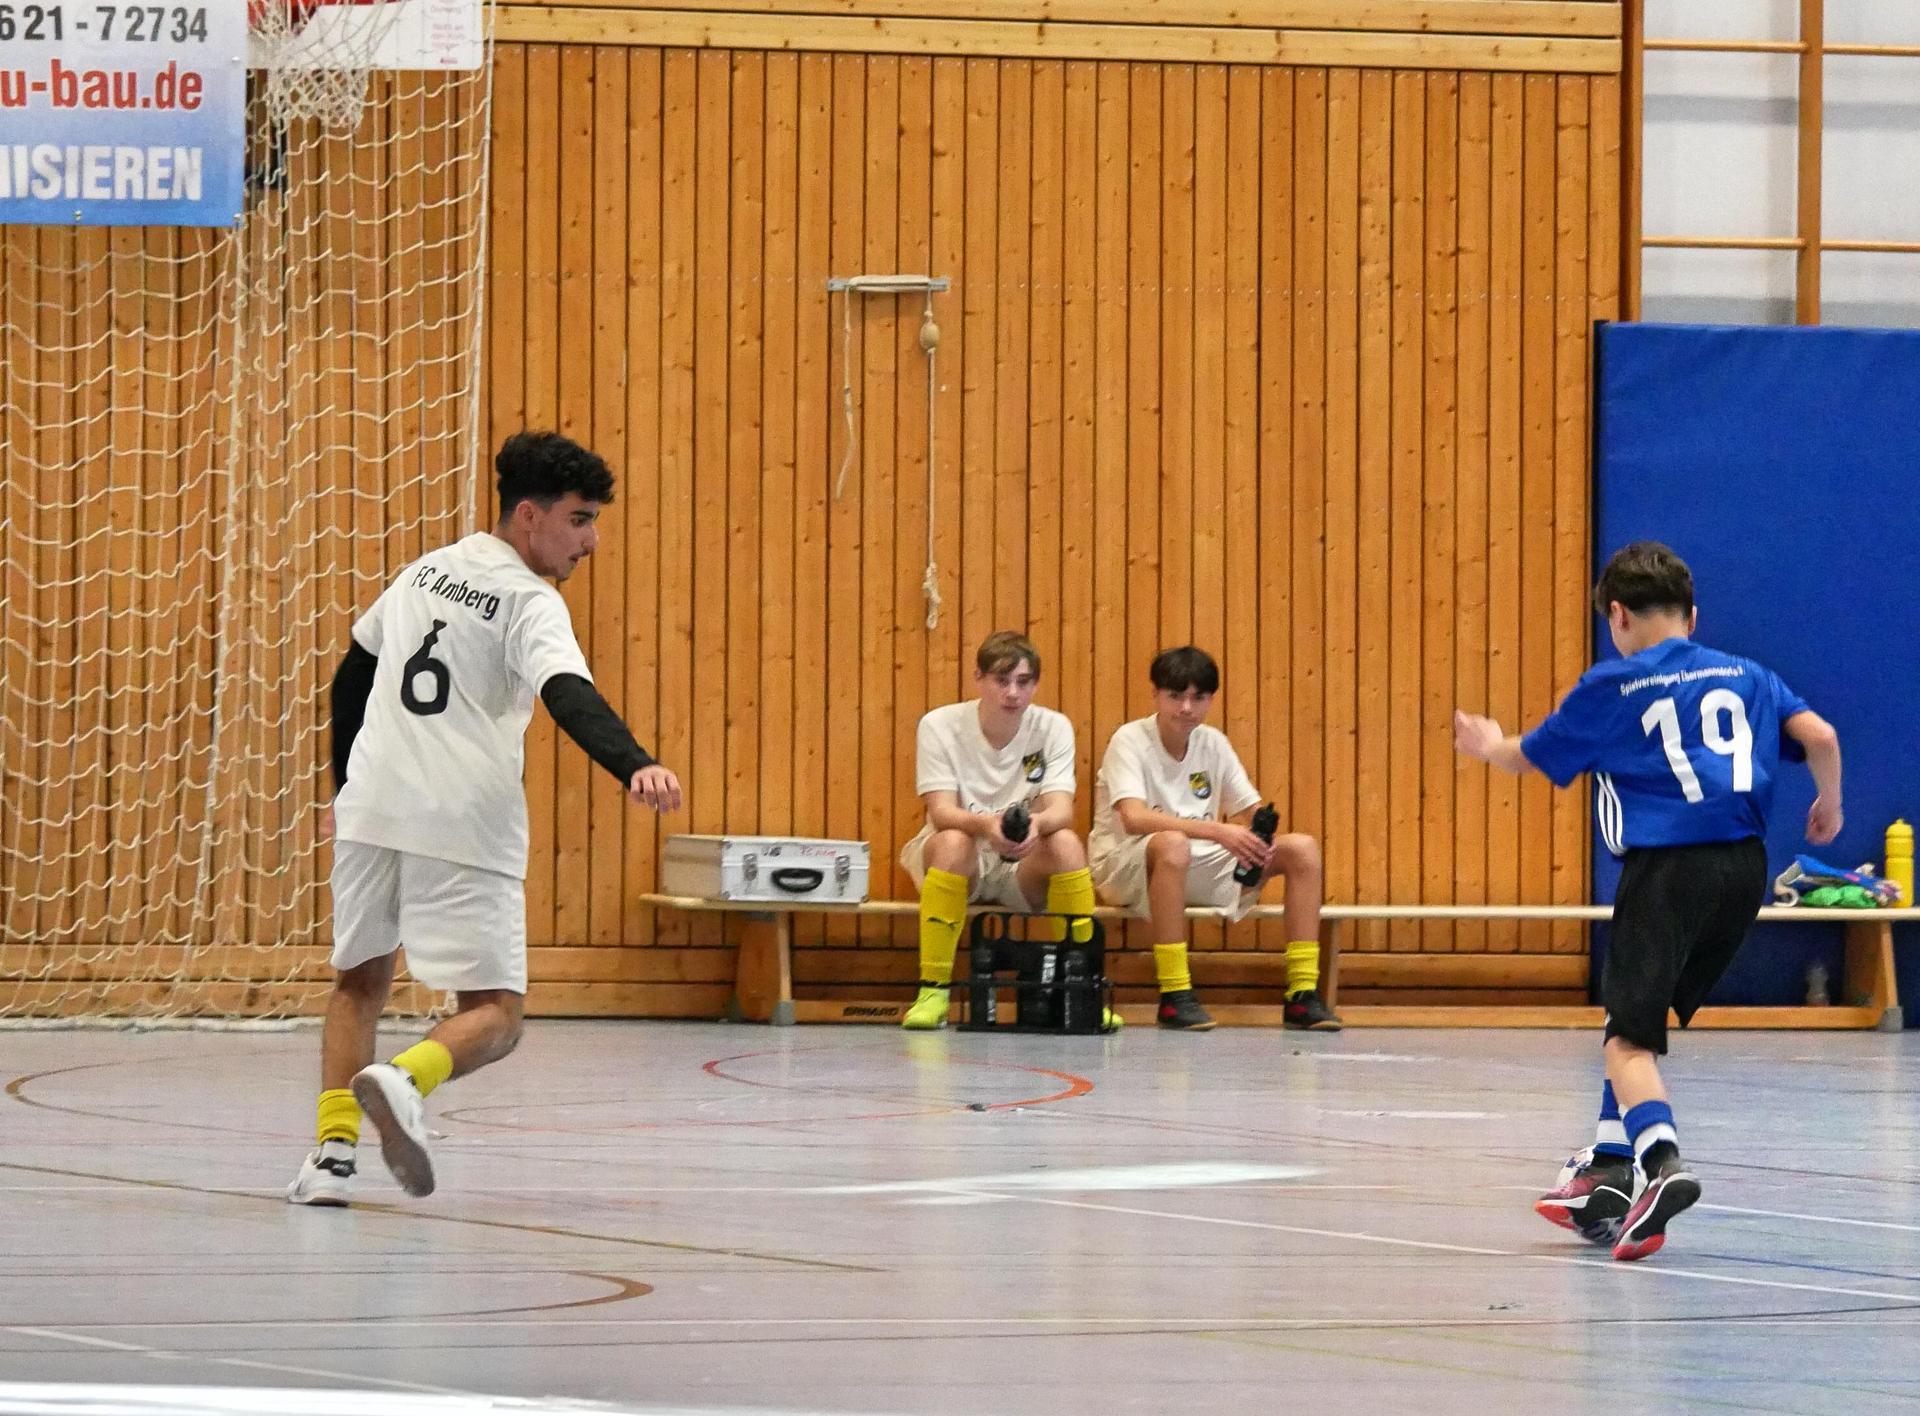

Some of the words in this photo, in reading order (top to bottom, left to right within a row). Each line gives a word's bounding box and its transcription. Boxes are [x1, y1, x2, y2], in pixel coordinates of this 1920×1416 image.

[411, 565, 436, 588] FC
[429, 573, 501, 621] Amberg
[400, 618, 450, 717] 6
[1641, 688, 1753, 803] 19
